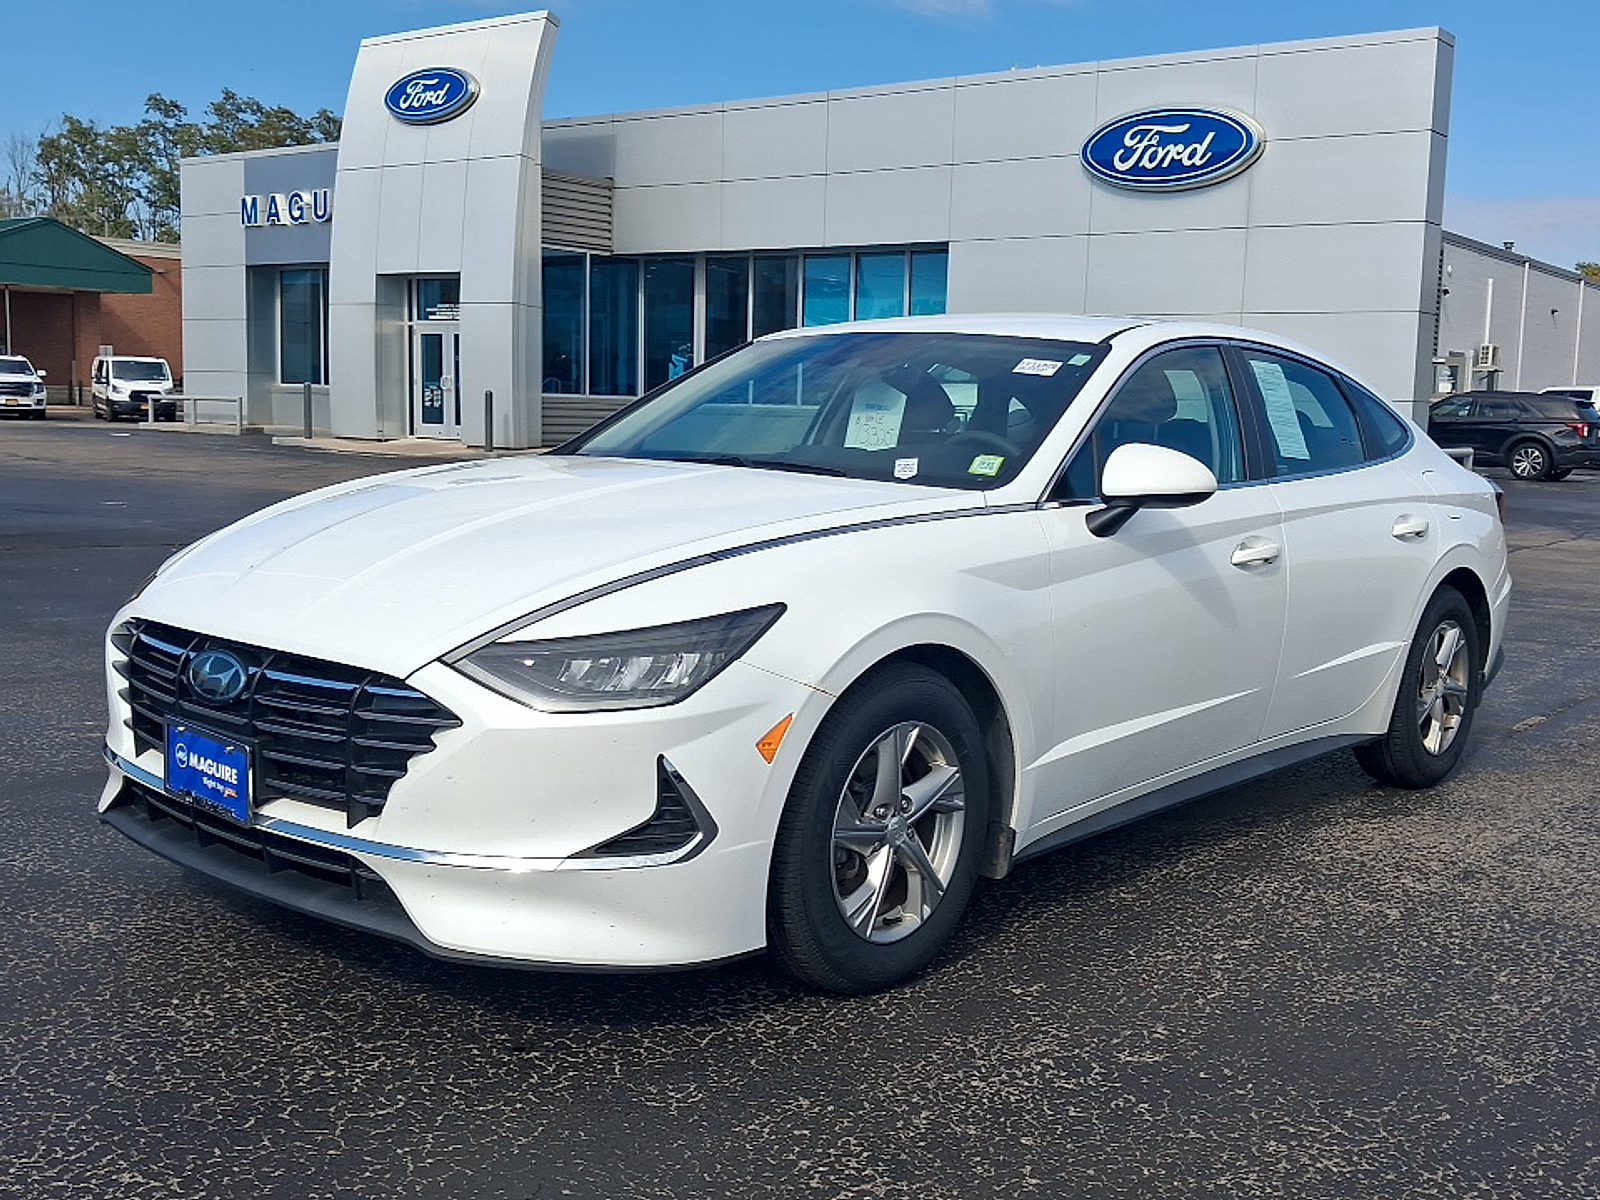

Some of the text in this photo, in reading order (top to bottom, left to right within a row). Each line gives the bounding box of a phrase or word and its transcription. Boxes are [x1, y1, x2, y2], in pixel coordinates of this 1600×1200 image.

[400, 79, 450, 109] Ford
[1113, 123, 1216, 171] Ford
[241, 188, 330, 227] MAGU
[189, 752, 238, 785] MAGUIRE
